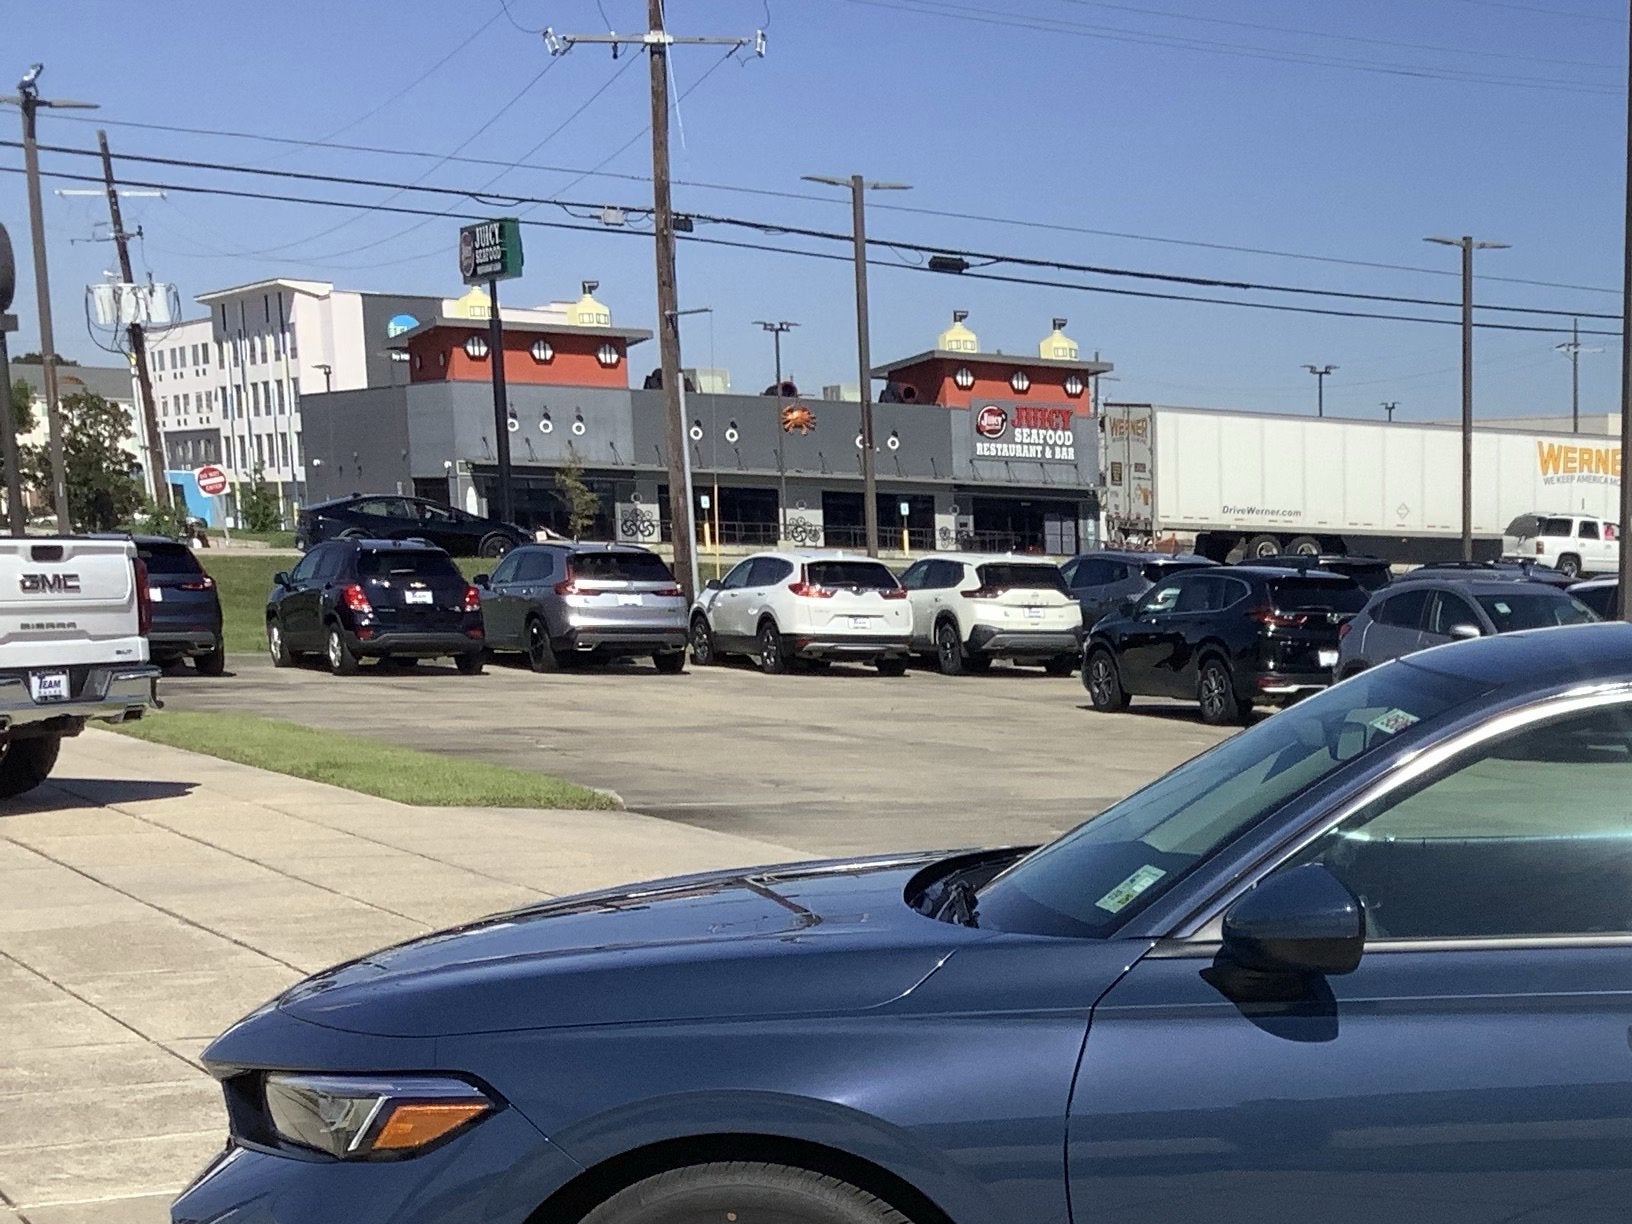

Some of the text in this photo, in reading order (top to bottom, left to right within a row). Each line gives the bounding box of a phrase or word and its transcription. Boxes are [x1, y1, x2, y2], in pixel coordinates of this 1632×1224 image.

[475, 223, 500, 249] JUICY
[1011, 407, 1073, 431] JUICY
[1014, 428, 1074, 446] SEAFOOD
[976, 442, 1075, 460] RESTAURANT & BAR
[1537, 440, 1622, 477] WERNE
[1222, 505, 1302, 517] DriveWerner.com
[19, 574, 81, 592] GMC
[38, 673, 62, 690] TEAM
